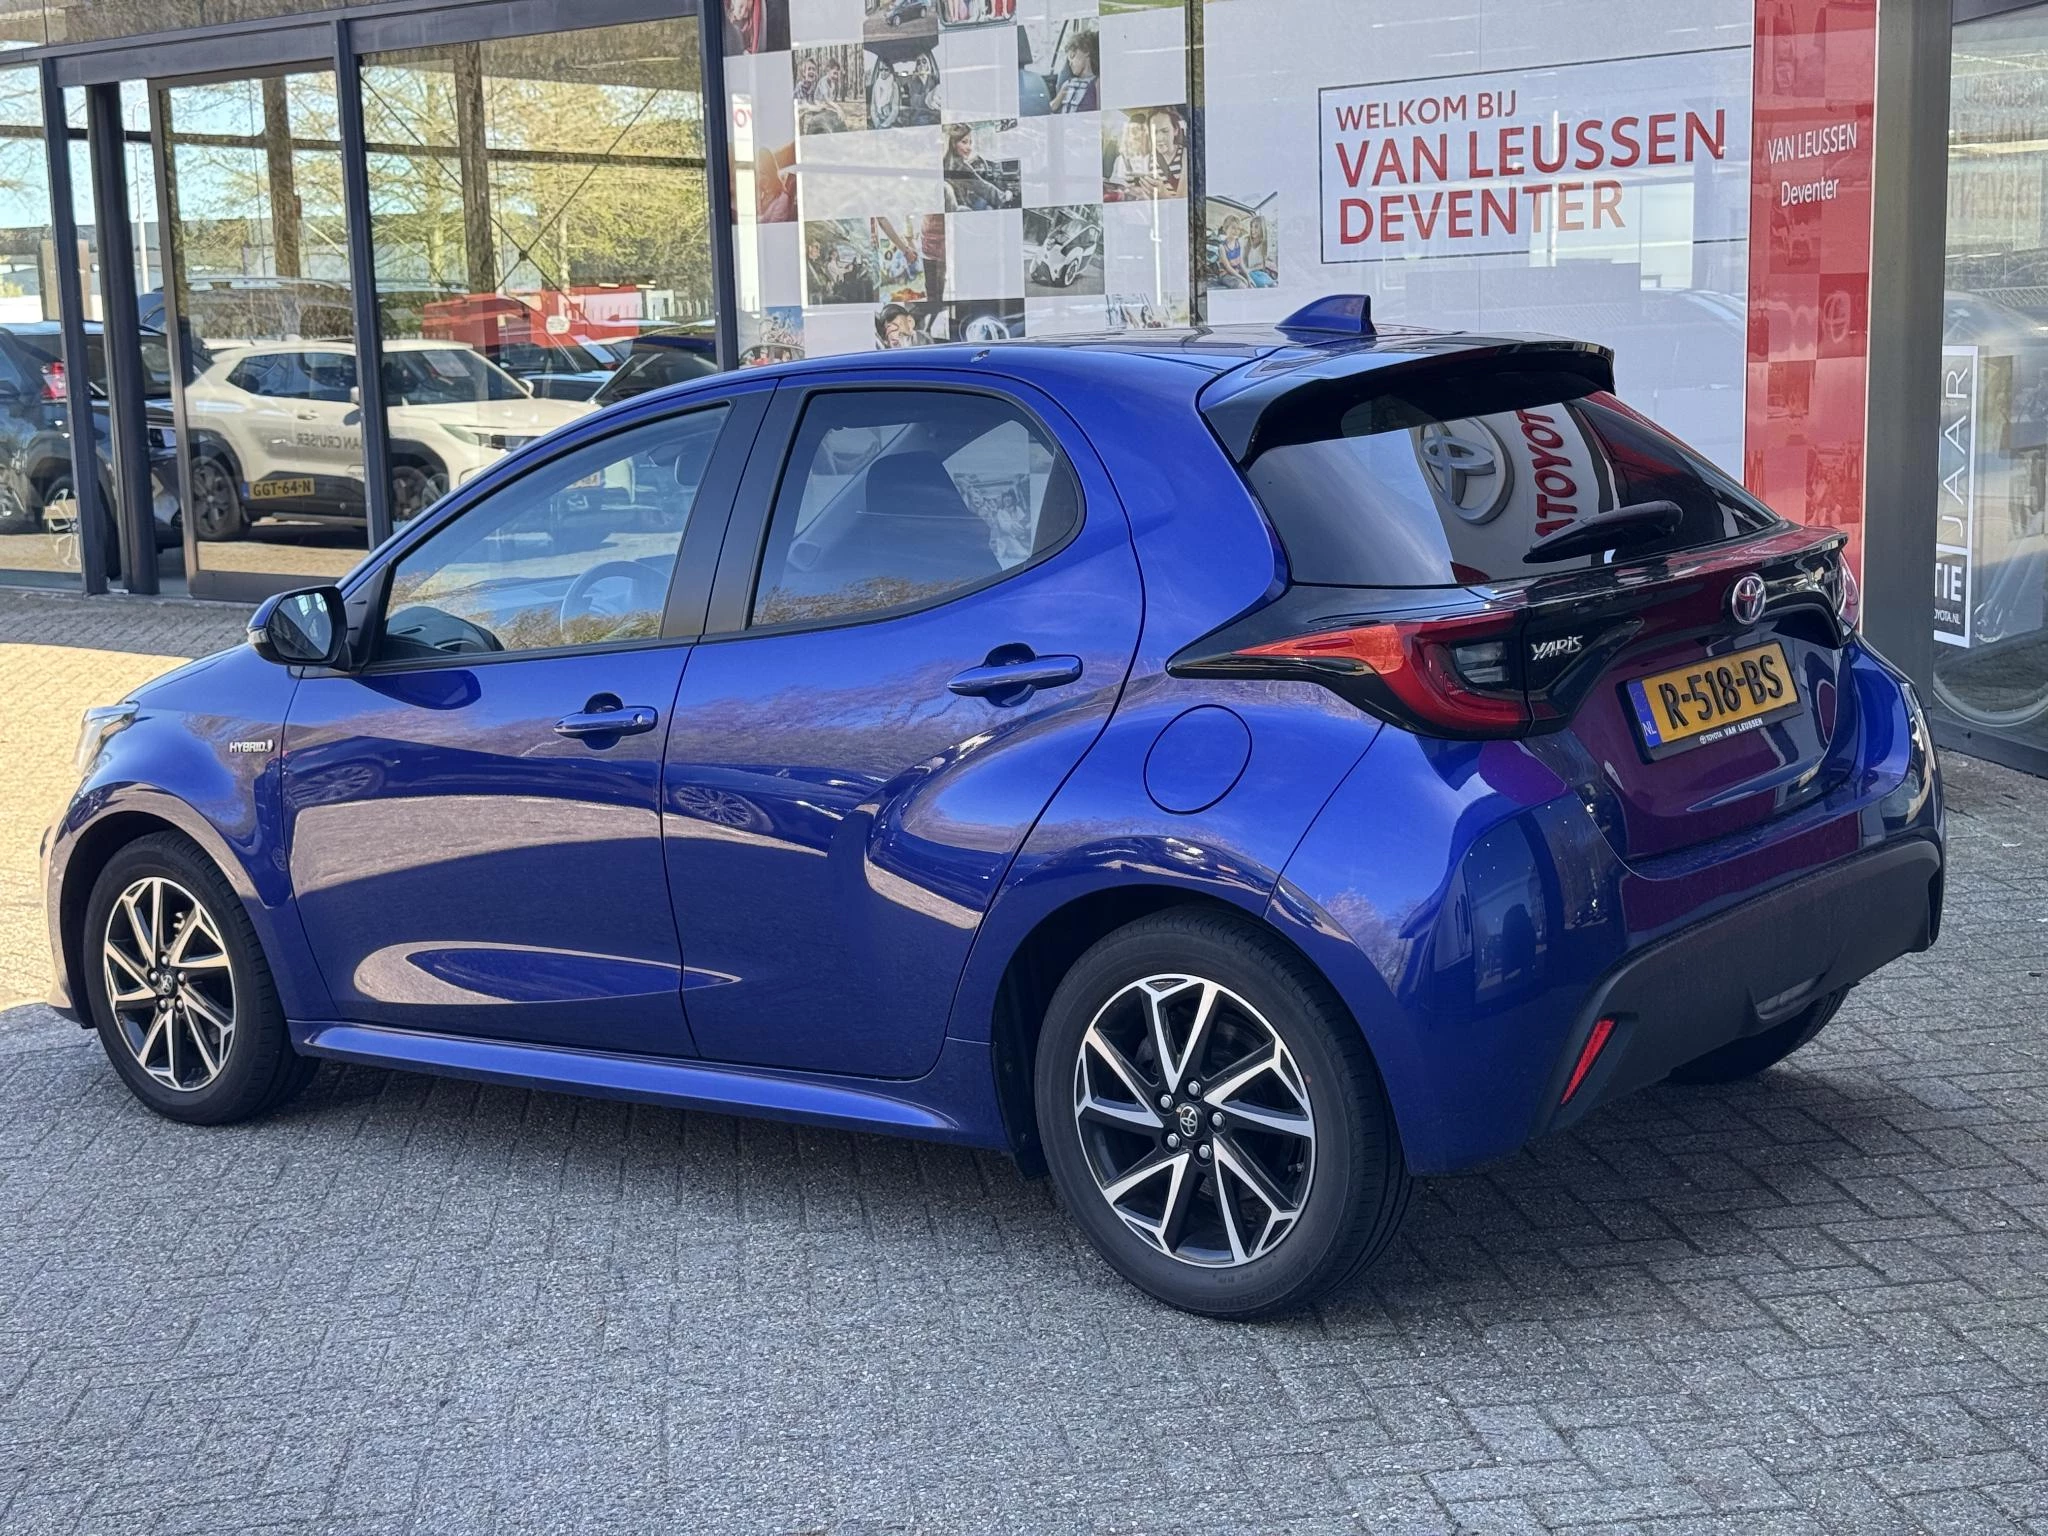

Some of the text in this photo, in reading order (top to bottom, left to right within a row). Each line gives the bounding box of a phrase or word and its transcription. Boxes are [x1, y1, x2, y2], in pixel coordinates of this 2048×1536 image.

[1336, 90, 1517, 131] WELKOM BIJ
[1336, 109, 1726, 188] VAN LEUSSEN
[1768, 122, 1858, 164] VAN LEUSSEN
[1340, 180, 1626, 244] DEVENTER
[1781, 176, 1840, 207] Deventer
[1942, 368, 1968, 538] JAAR
[253, 481, 312, 497] GGT-64-N
[1659, 654, 1784, 730] R-518-BS
[229, 741, 266, 753] HYBRID
[1642, 721, 1657, 736] NL
[1724, 725, 1737, 736] VAN
[1738, 718, 1764, 732] LEUSSEN
